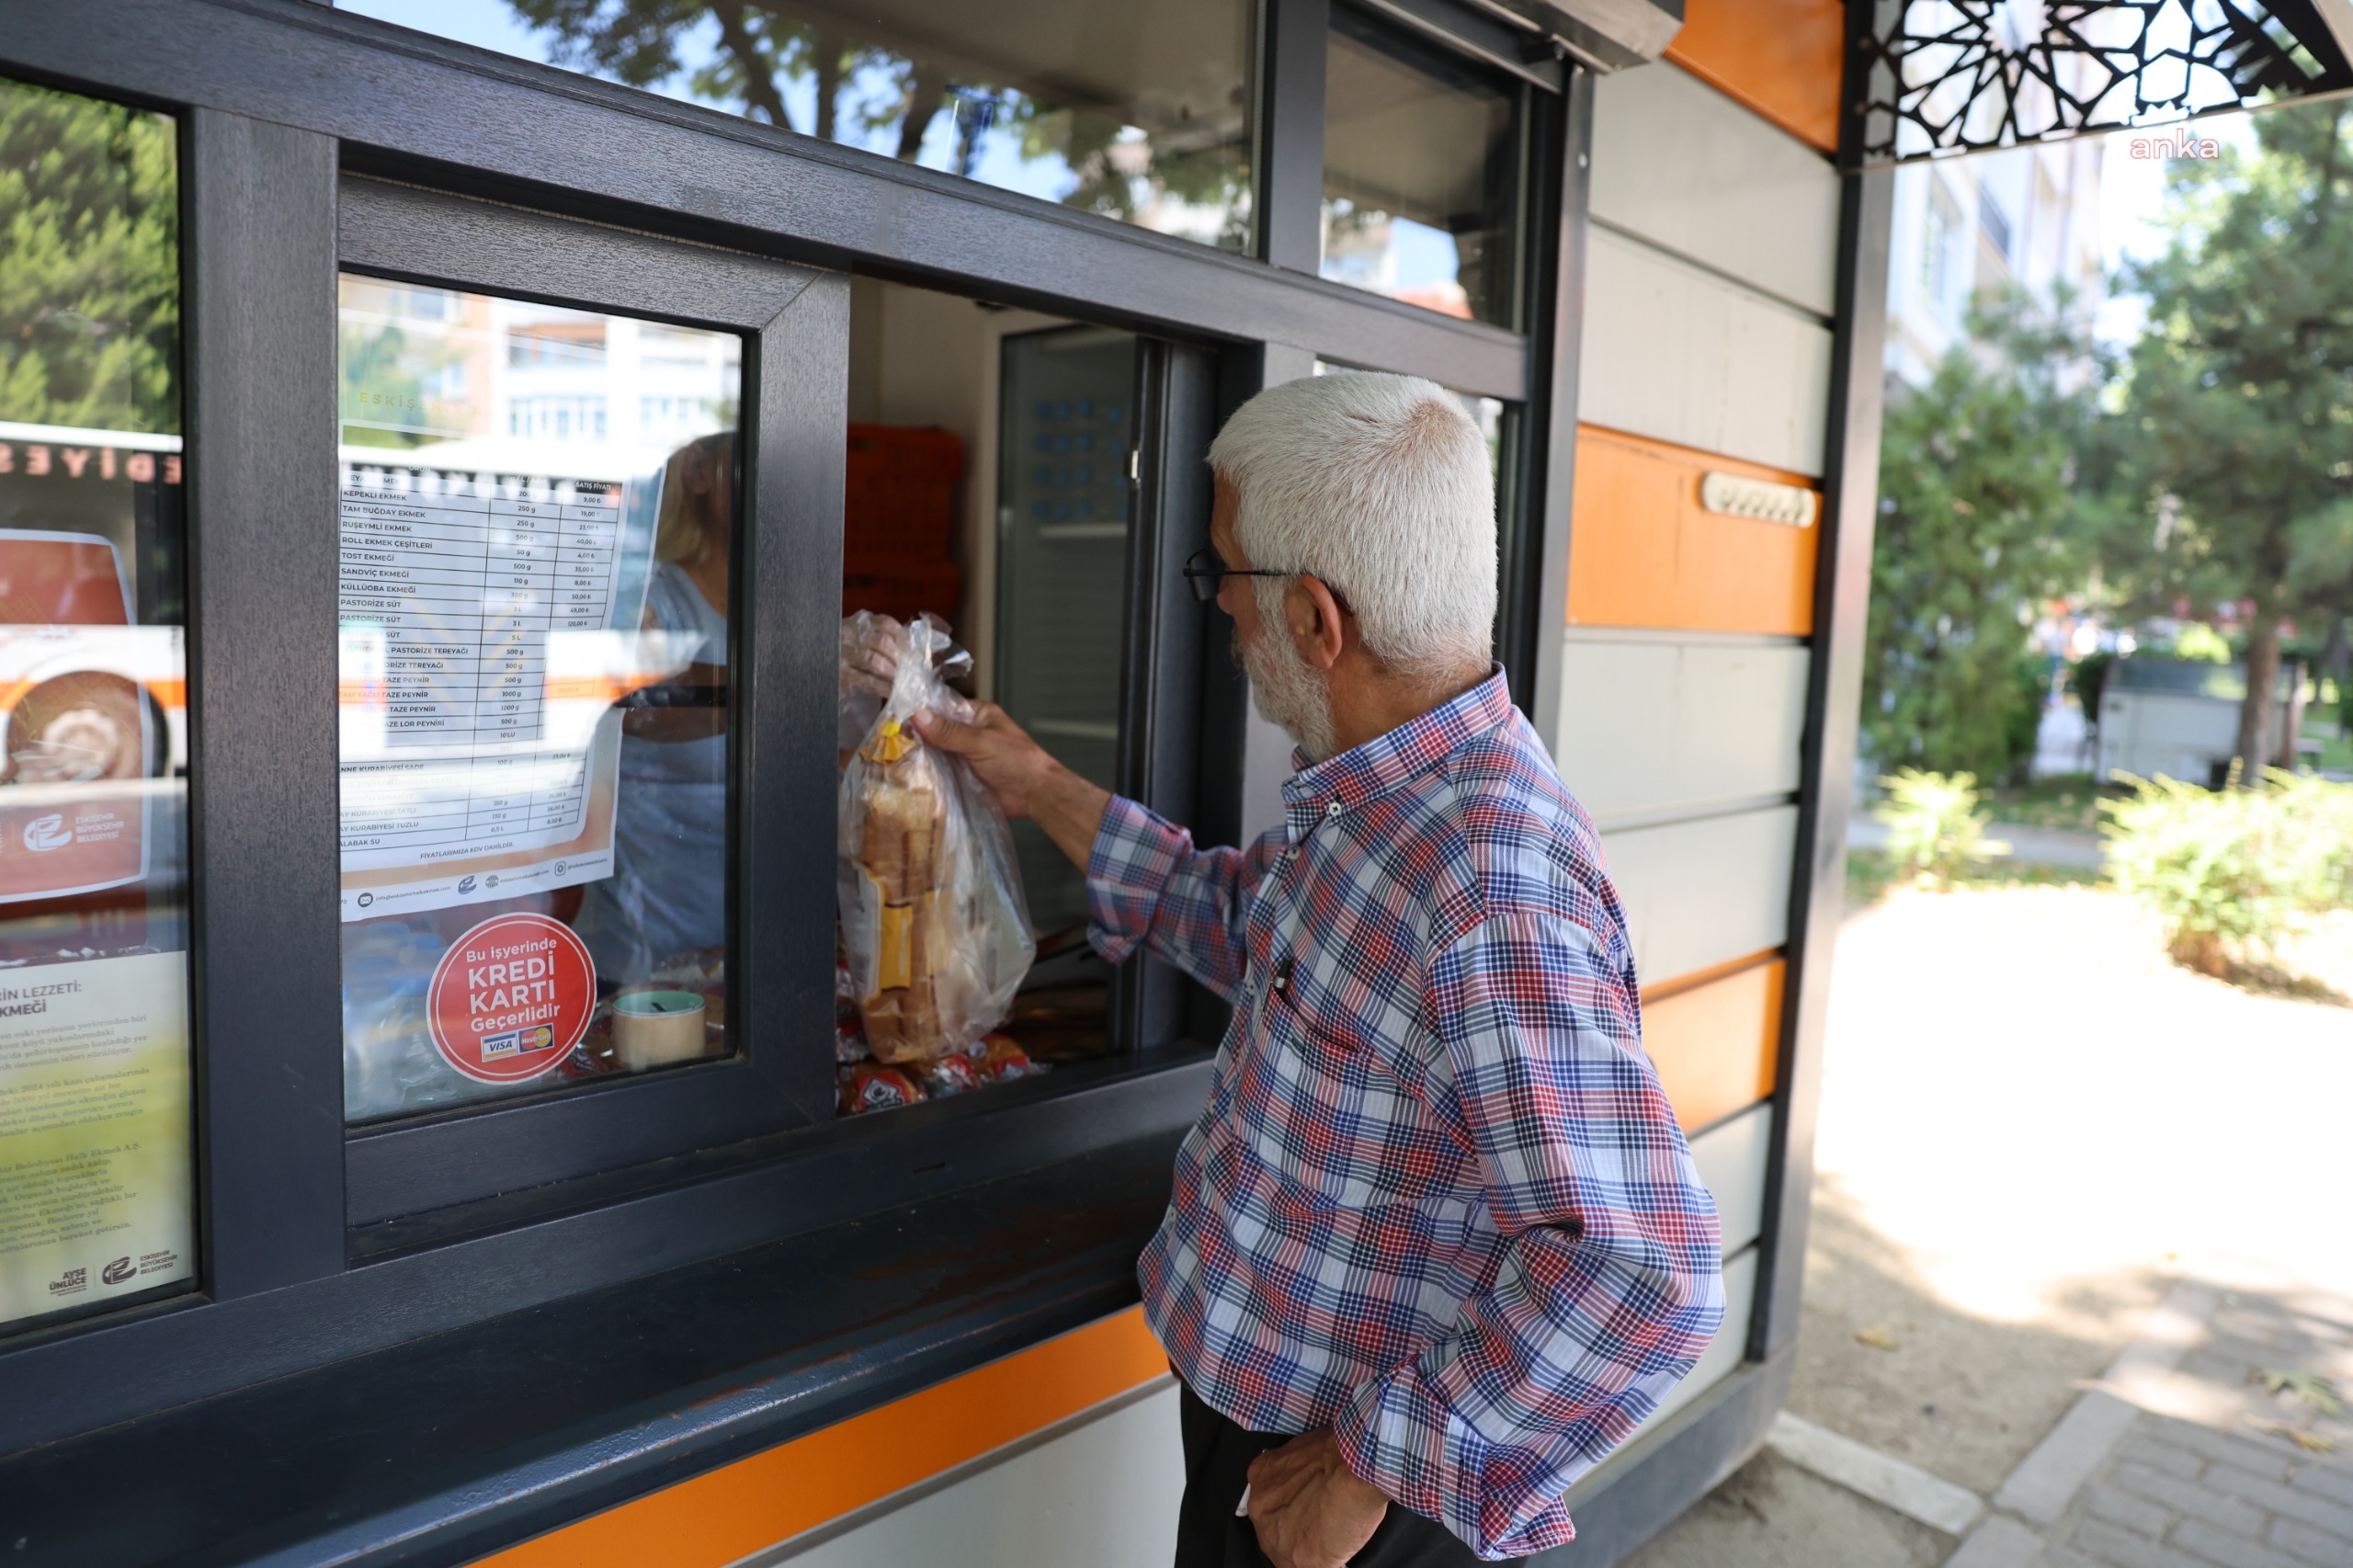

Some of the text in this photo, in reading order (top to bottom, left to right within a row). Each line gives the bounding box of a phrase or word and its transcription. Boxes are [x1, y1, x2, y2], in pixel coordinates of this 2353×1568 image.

[343, 489, 407, 501] KEPEKLİ EKMEK
[363, 506, 397, 517] BUĞDAY
[398, 510, 426, 518] EKMEK
[342, 521, 412, 533] RUŞEYMLİ EKMEK
[365, 538, 393, 547] EKMEK
[394, 540, 433, 550] ÇEŞİTLERİ
[364, 553, 395, 562] EKMEĞİ
[341, 568, 409, 579] SANDVİÇ EKMEĞİ
[341, 583, 416, 594] KÜLLÜOBA EKMEĞİ
[340, 598, 385, 608] PASTORİZE
[340, 614, 384, 623] PASTORİZE
[391, 646, 468, 655] PASTORİZE TEREYAĞI
[408, 661, 443, 670] TEREYAĞI
[409, 705, 436, 713] PEYNİR
[416, 719, 444, 727] PEYNİRİ
[359, 763, 404, 773] KURABİYESİ
[351, 807, 395, 818] KURABİYESİ
[350, 822, 395, 832] KURABİYESİ
[396, 821, 419, 829] TUZLU
[339, 839, 368, 847] ALABAK
[420, 841, 515, 859] FİYATLARIMIZA KDV DAHİLDİR.
[466, 937, 558, 963] Bu işyerinde
[468, 949, 555, 990] KREDİ
[22, 979, 82, 999] LEZZETİ:
[470, 979, 555, 1015] KARTI
[0, 999, 46, 1018] KMEĞİ
[471, 1003, 561, 1032] Geçerlidir
[489, 1034, 551, 1052] VISA MasterCard
[49, 1275, 87, 1291] ÜNLÜCE
